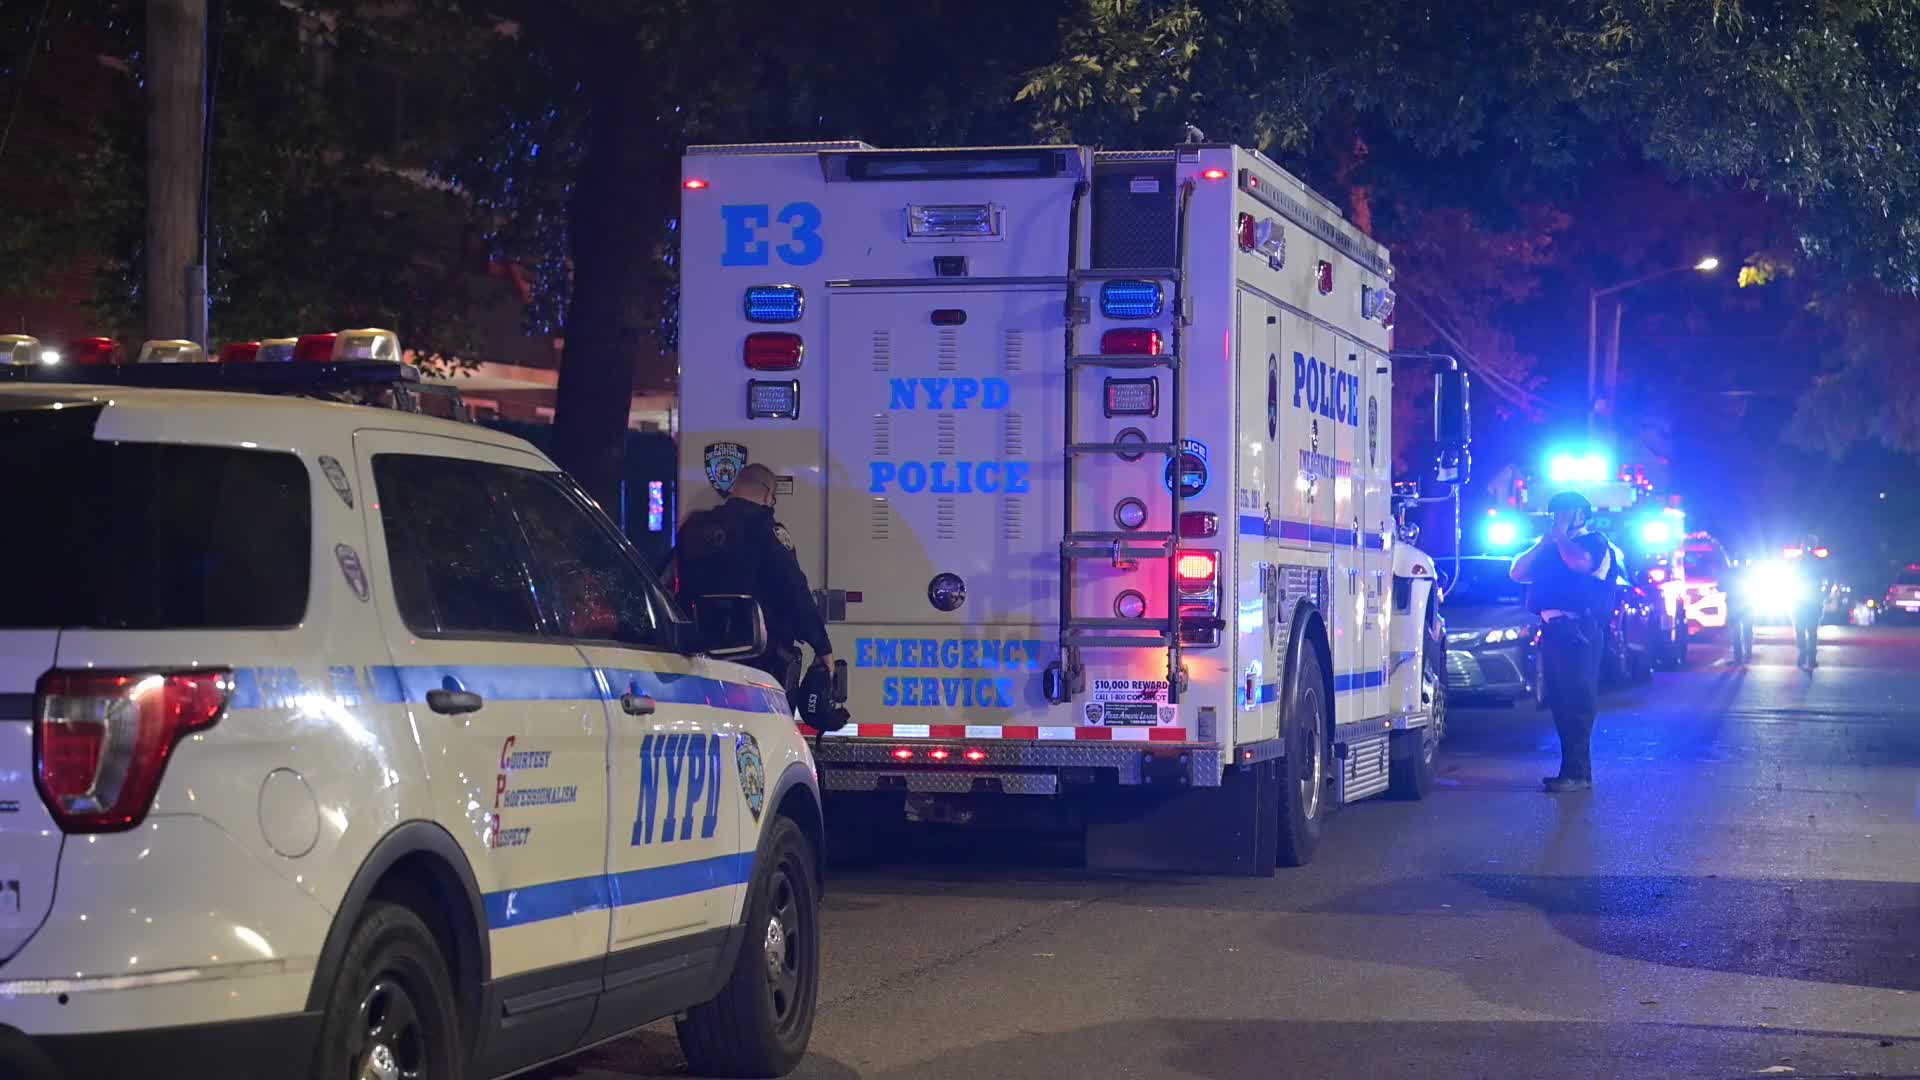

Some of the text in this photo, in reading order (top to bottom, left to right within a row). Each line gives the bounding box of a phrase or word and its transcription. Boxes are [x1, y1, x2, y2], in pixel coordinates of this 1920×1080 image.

[722, 202, 823, 266] E3
[889, 379, 1010, 409] NYPD
[1293, 351, 1358, 427] POLICE
[713, 443, 738, 451] POLICE
[870, 461, 1030, 494] POLICE
[855, 638, 1041, 669] EMERGENCY
[883, 678, 1013, 707] SERVICE
[1095, 681, 1167, 690] $10,000 REWARD
[501, 735, 551, 769] COURTESY
[495, 774, 577, 808] PROFESSIONALISM
[632, 733, 722, 846] NYPD
[491, 814, 530, 848] RESPECT
